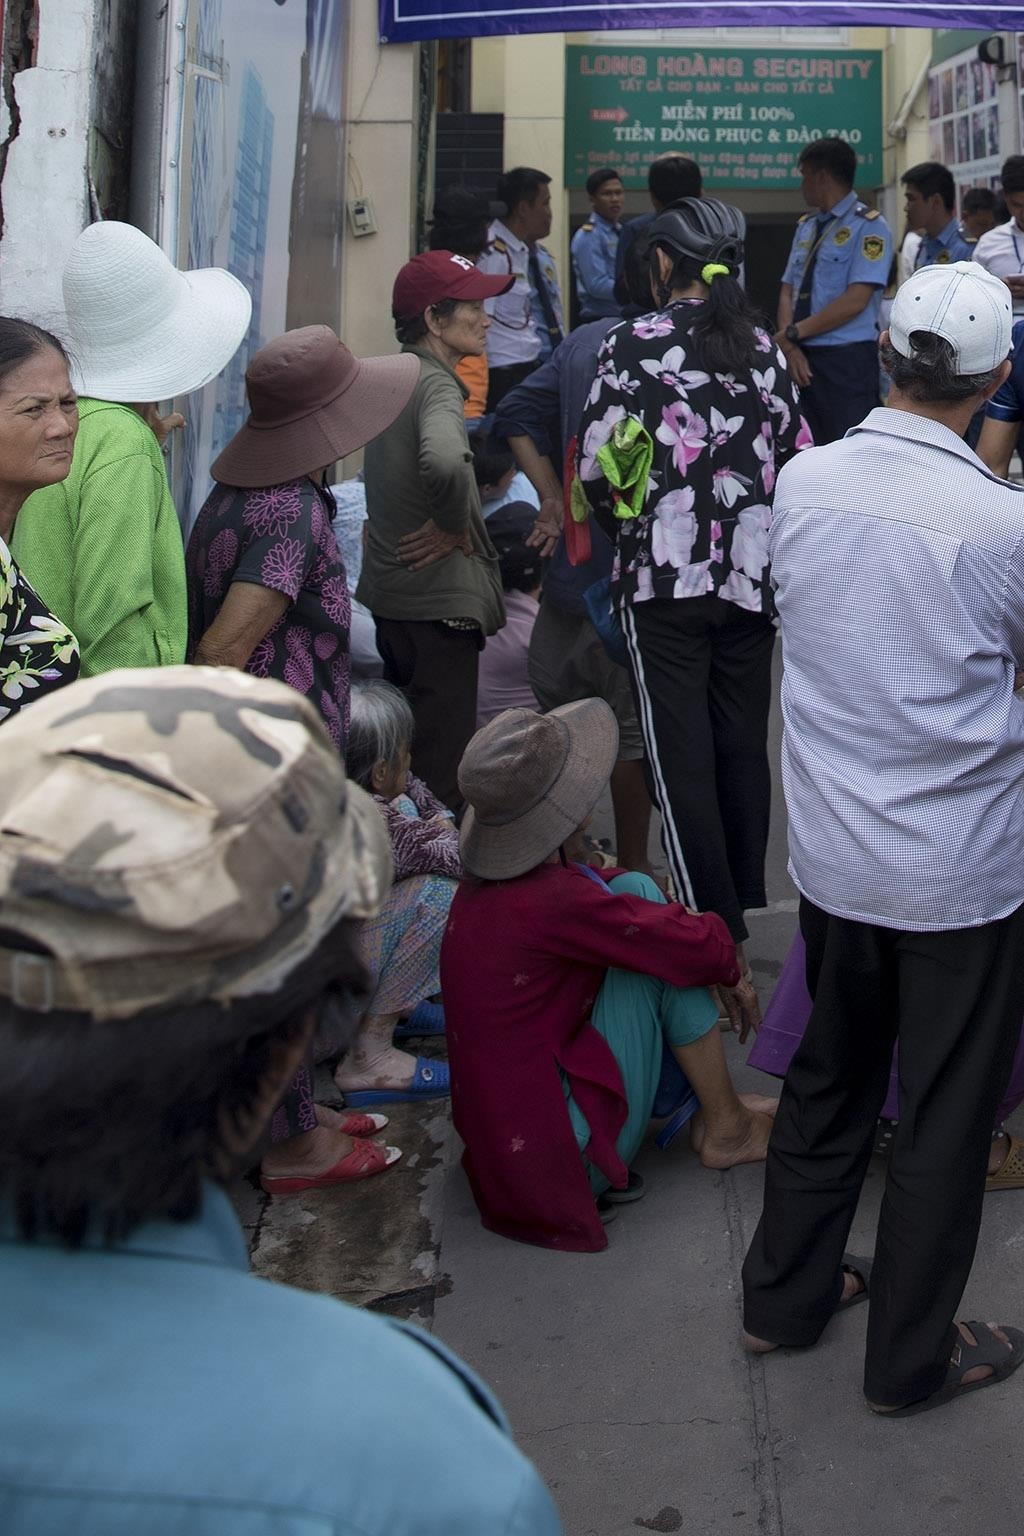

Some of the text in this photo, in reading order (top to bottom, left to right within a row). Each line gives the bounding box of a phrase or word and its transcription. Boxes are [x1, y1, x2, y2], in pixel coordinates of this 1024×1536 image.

[580, 52, 873, 79] LONG HOÀNG SECURITY
[713, 103, 744, 122] PHÍ
[749, 106, 795, 122] 100%
[768, 128, 781, 142] &
